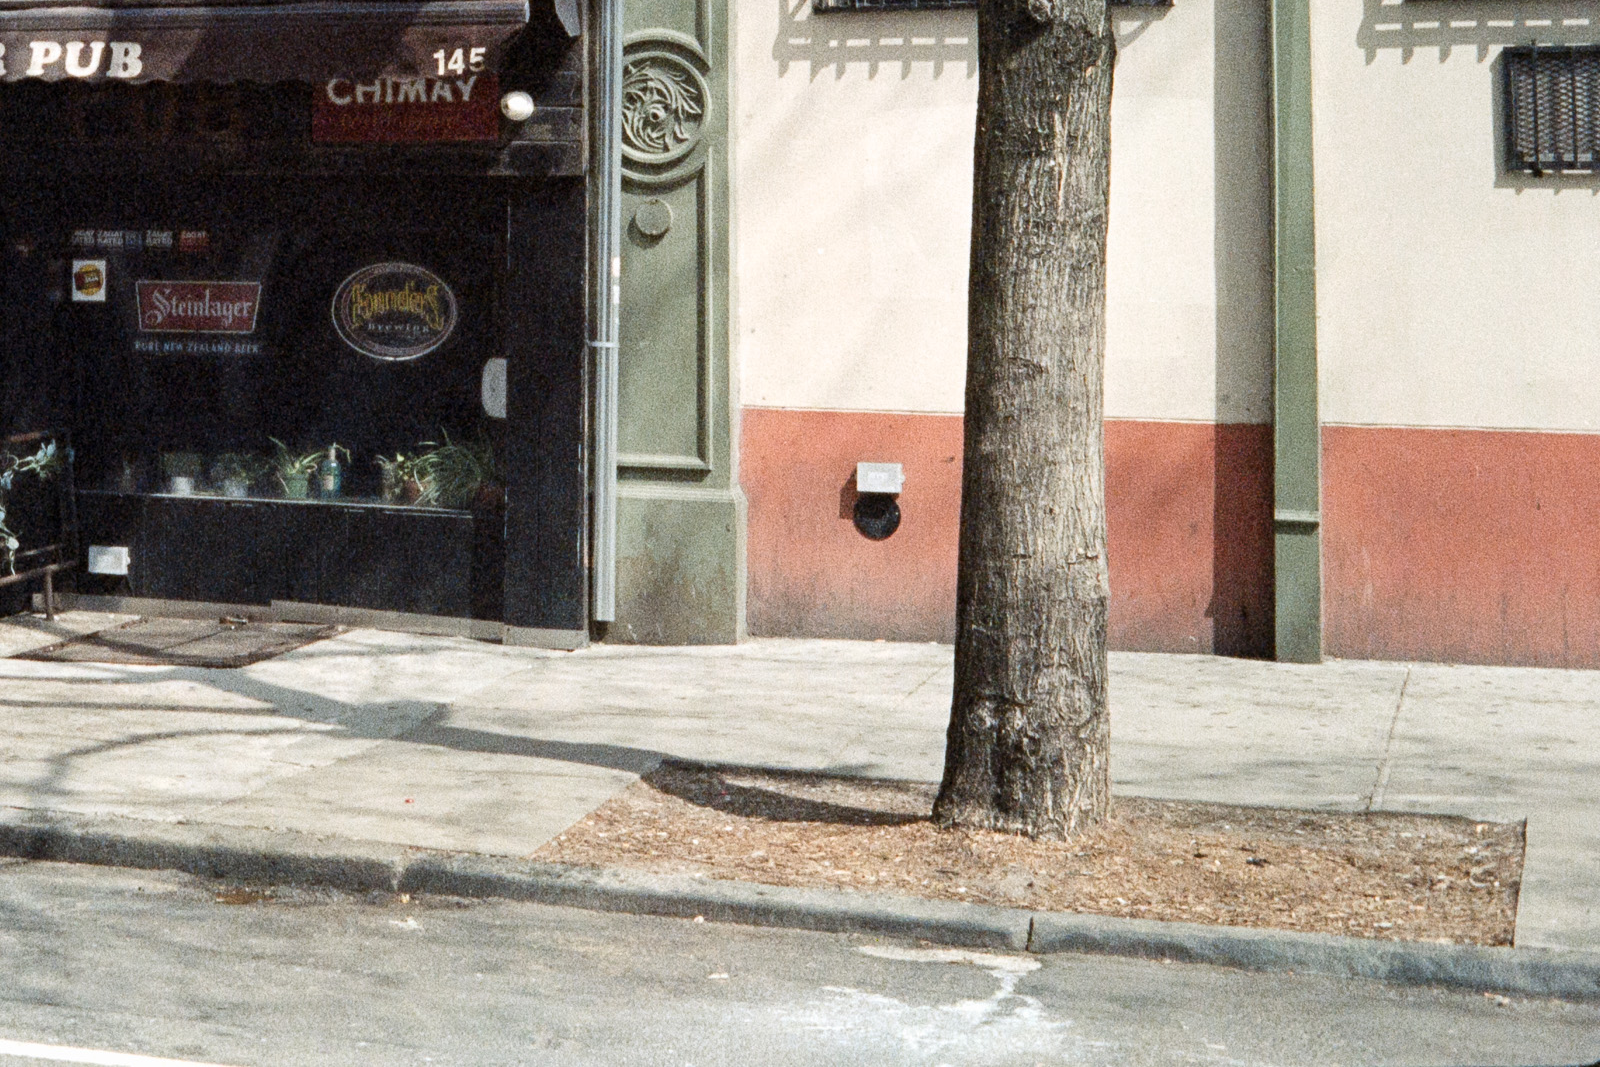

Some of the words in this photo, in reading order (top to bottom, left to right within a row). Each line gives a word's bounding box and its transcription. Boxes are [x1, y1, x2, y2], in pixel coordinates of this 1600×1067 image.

[25, 40, 143, 78] PUB
[432, 47, 486, 75] 145
[326, 75, 477, 105] CHIMAY
[145, 288, 253, 326] Steinlager
[163, 342, 183, 352] NEW
[187, 342, 231, 353] ZEALAND
